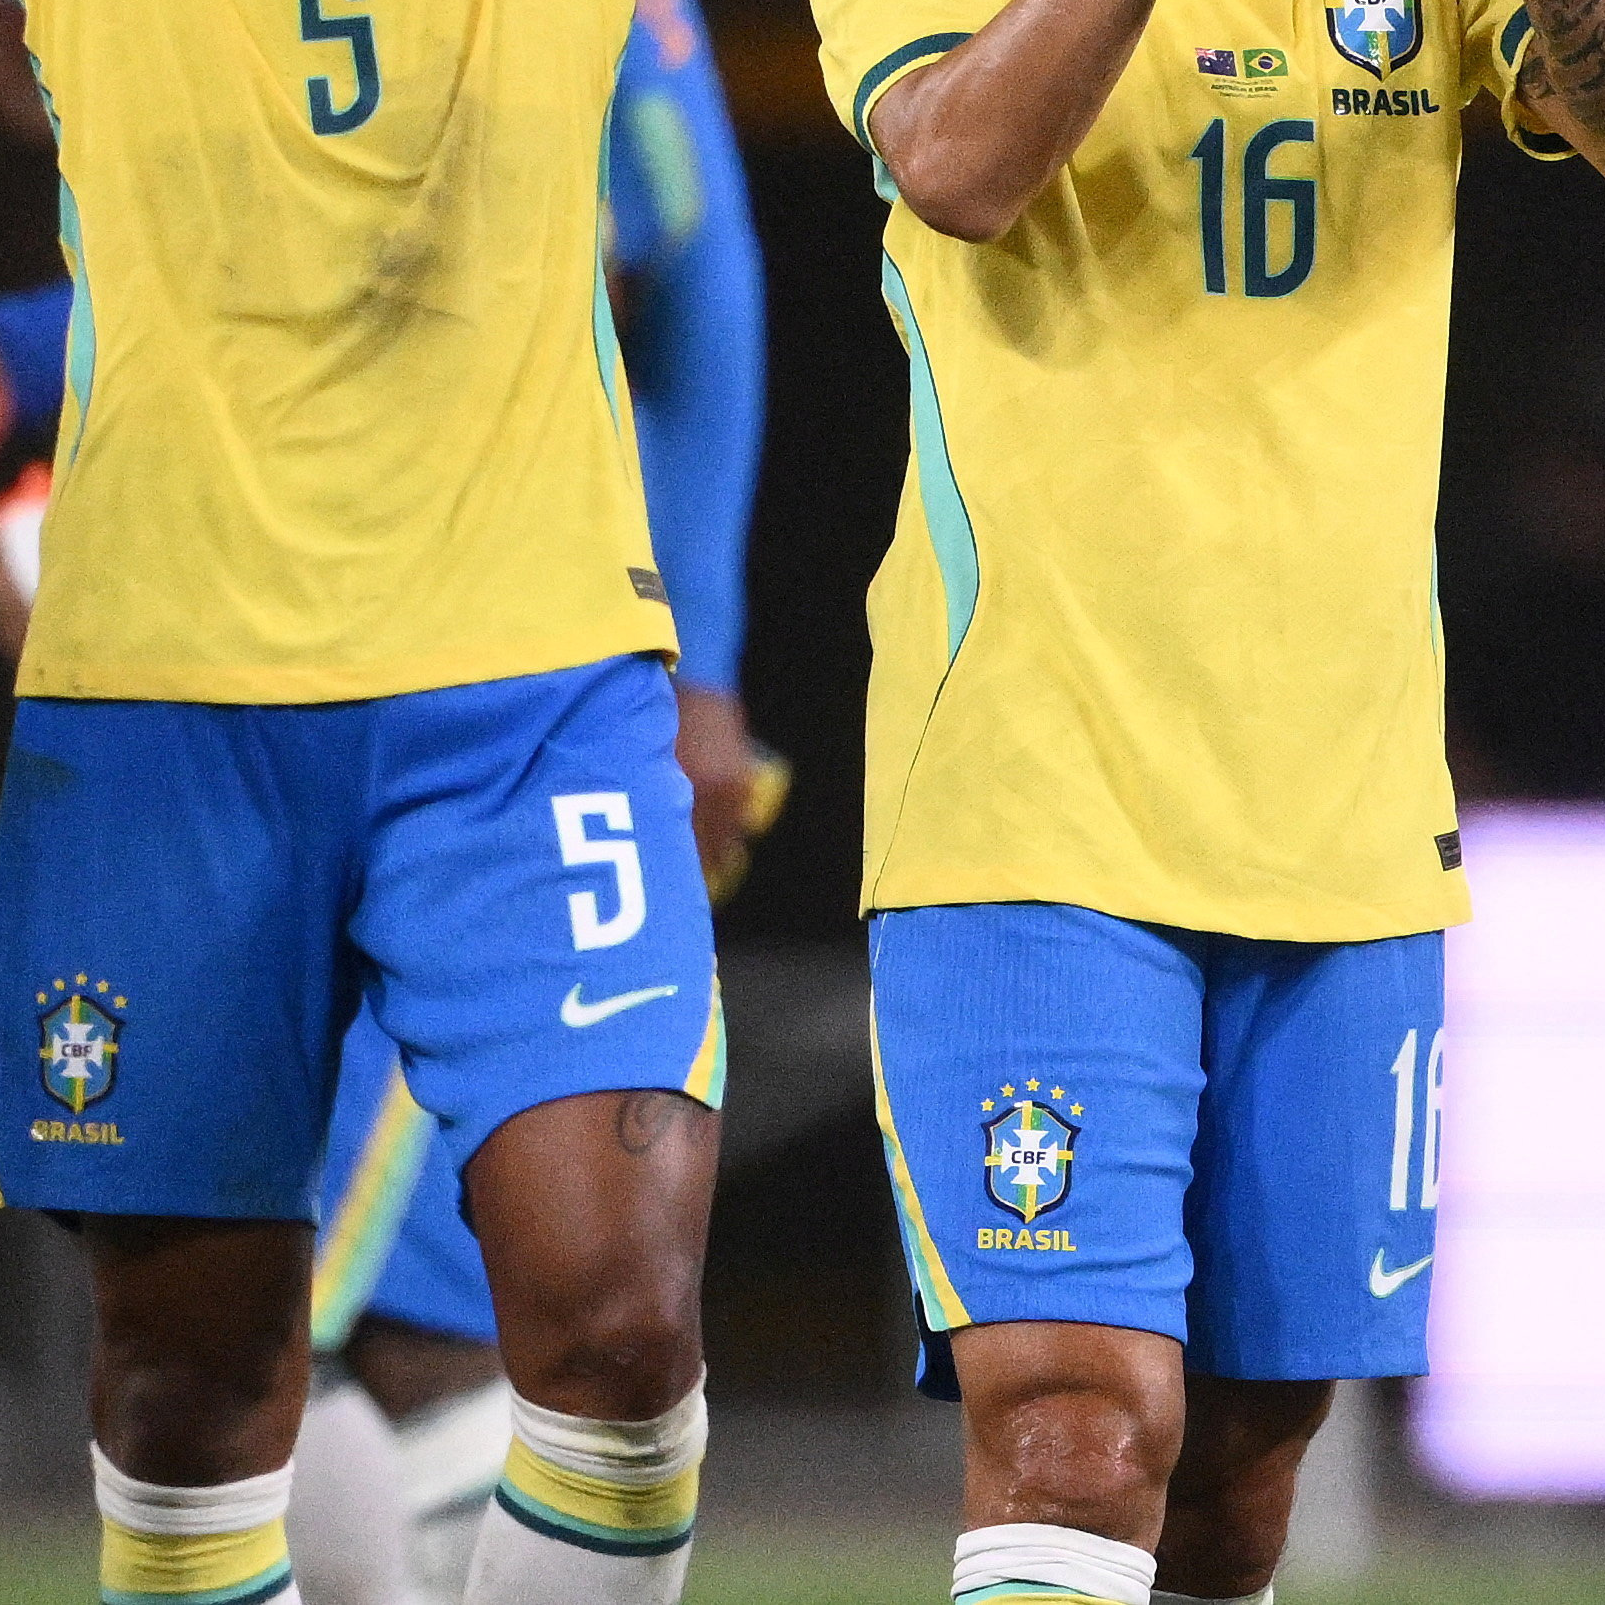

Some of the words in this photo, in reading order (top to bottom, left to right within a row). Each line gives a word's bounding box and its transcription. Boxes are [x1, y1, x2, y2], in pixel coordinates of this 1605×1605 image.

[1331, 88, 1440, 116] BRASIL
[1189, 117, 1318, 300] 16
[551, 791, 648, 953] 5
[60, 1043, 93, 1058] CBF
[29, 1120, 126, 1145] BRASIL
[1011, 1150, 1047, 1165] CBF
[976, 1228, 1078, 1252] BRASIL
